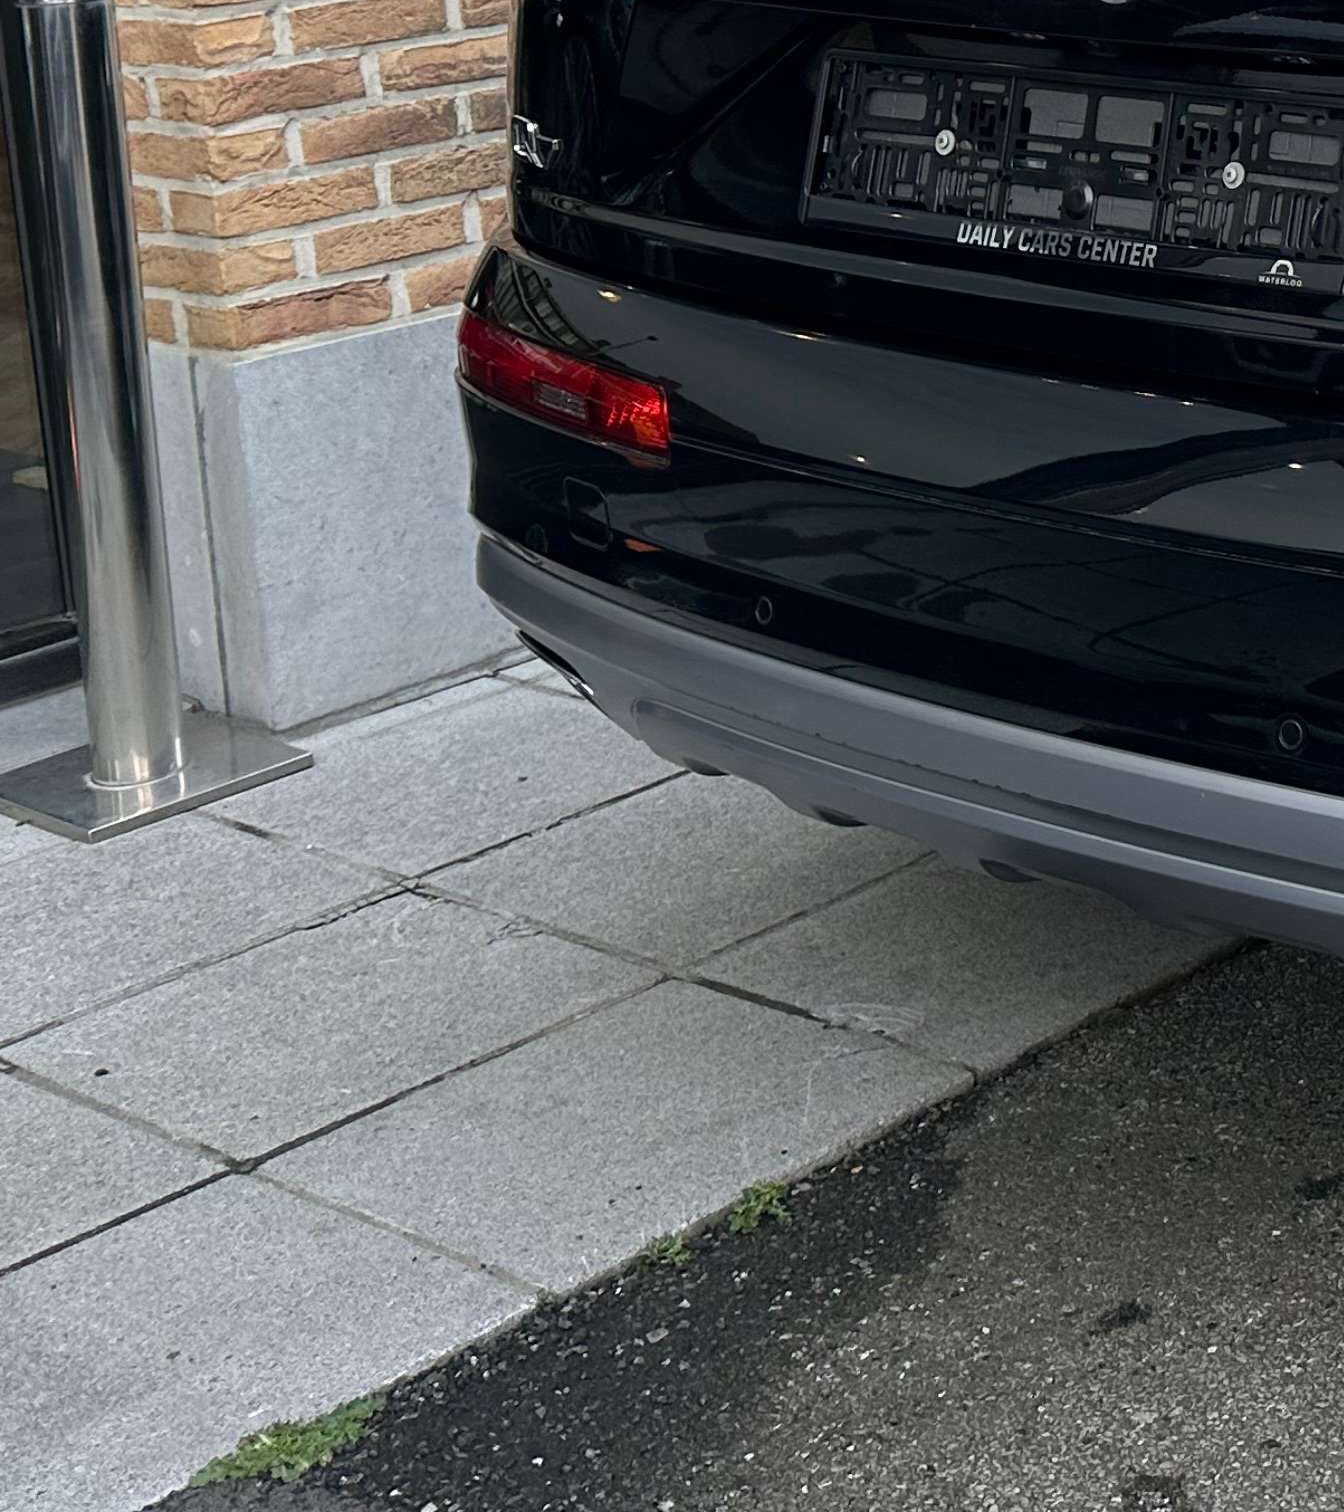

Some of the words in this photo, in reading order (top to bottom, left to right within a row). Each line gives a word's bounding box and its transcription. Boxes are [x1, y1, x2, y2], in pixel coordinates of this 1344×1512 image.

[957, 222, 1016, 250] DAILY
[1017, 227, 1073, 257] CARS
[1076, 234, 1158, 269] CENTER
[1258, 274, 1303, 288] WATERLOO
